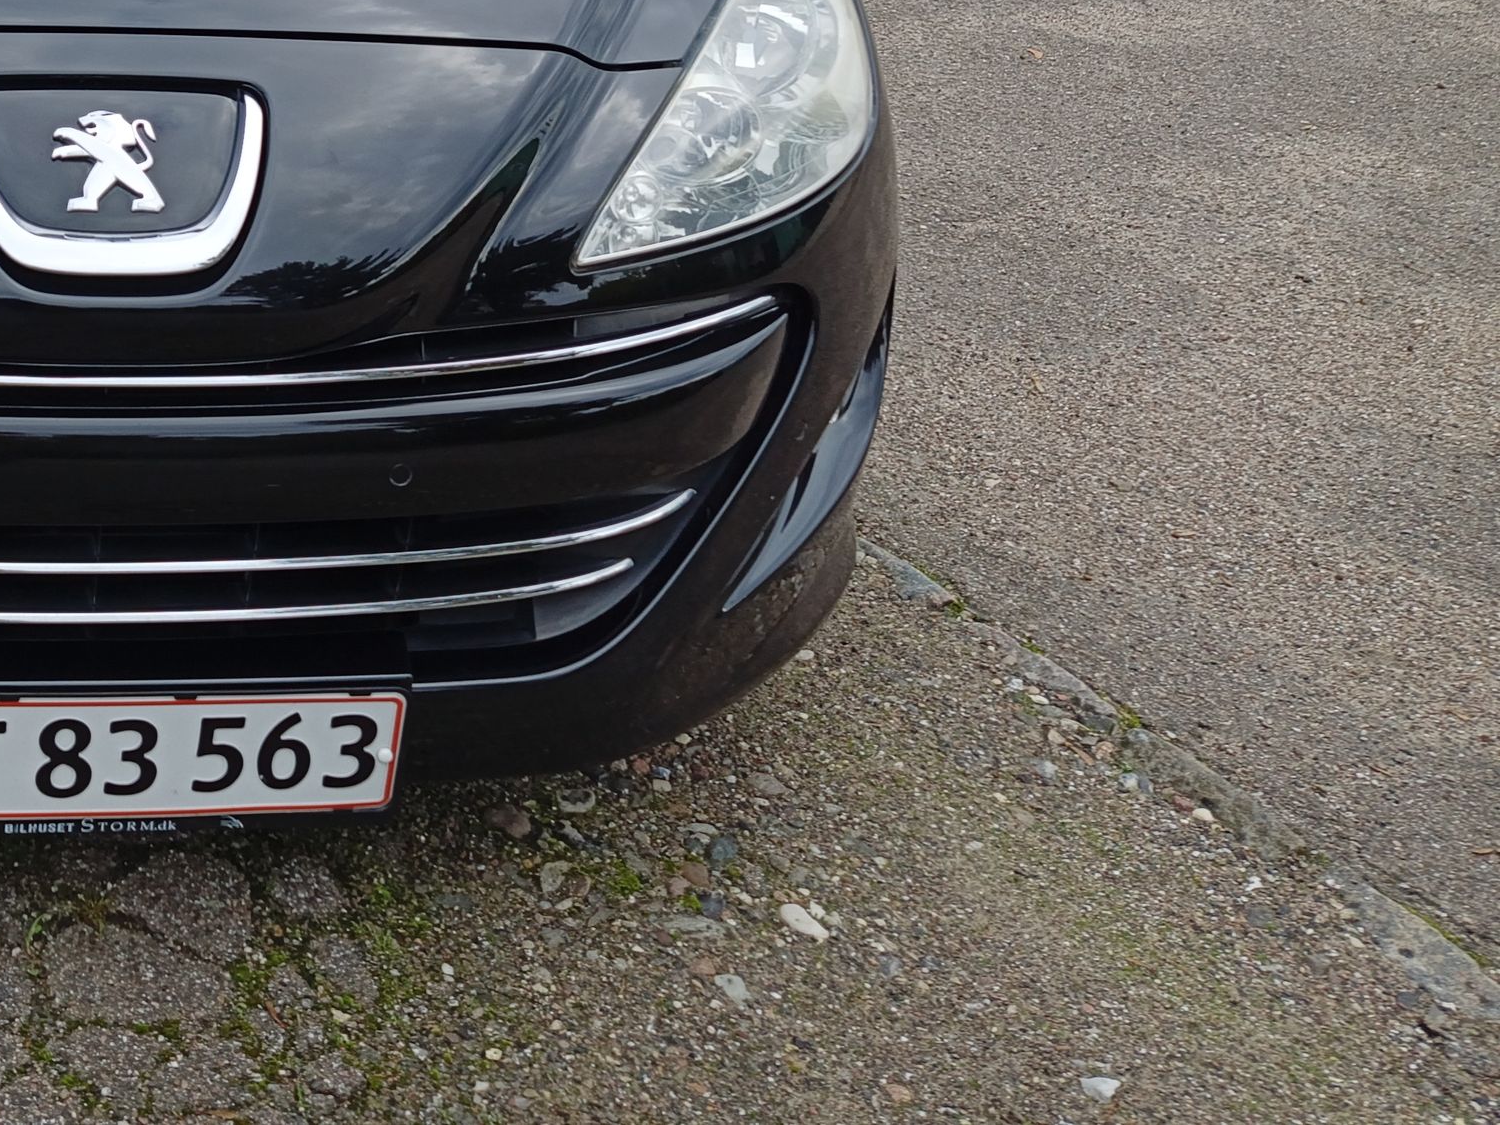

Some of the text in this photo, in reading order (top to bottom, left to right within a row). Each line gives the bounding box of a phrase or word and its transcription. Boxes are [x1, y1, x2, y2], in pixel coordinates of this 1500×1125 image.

[35, 718, 159, 798] 83
[191, 712, 378, 793] 563
[4, 822, 75, 834] BILHUSET
